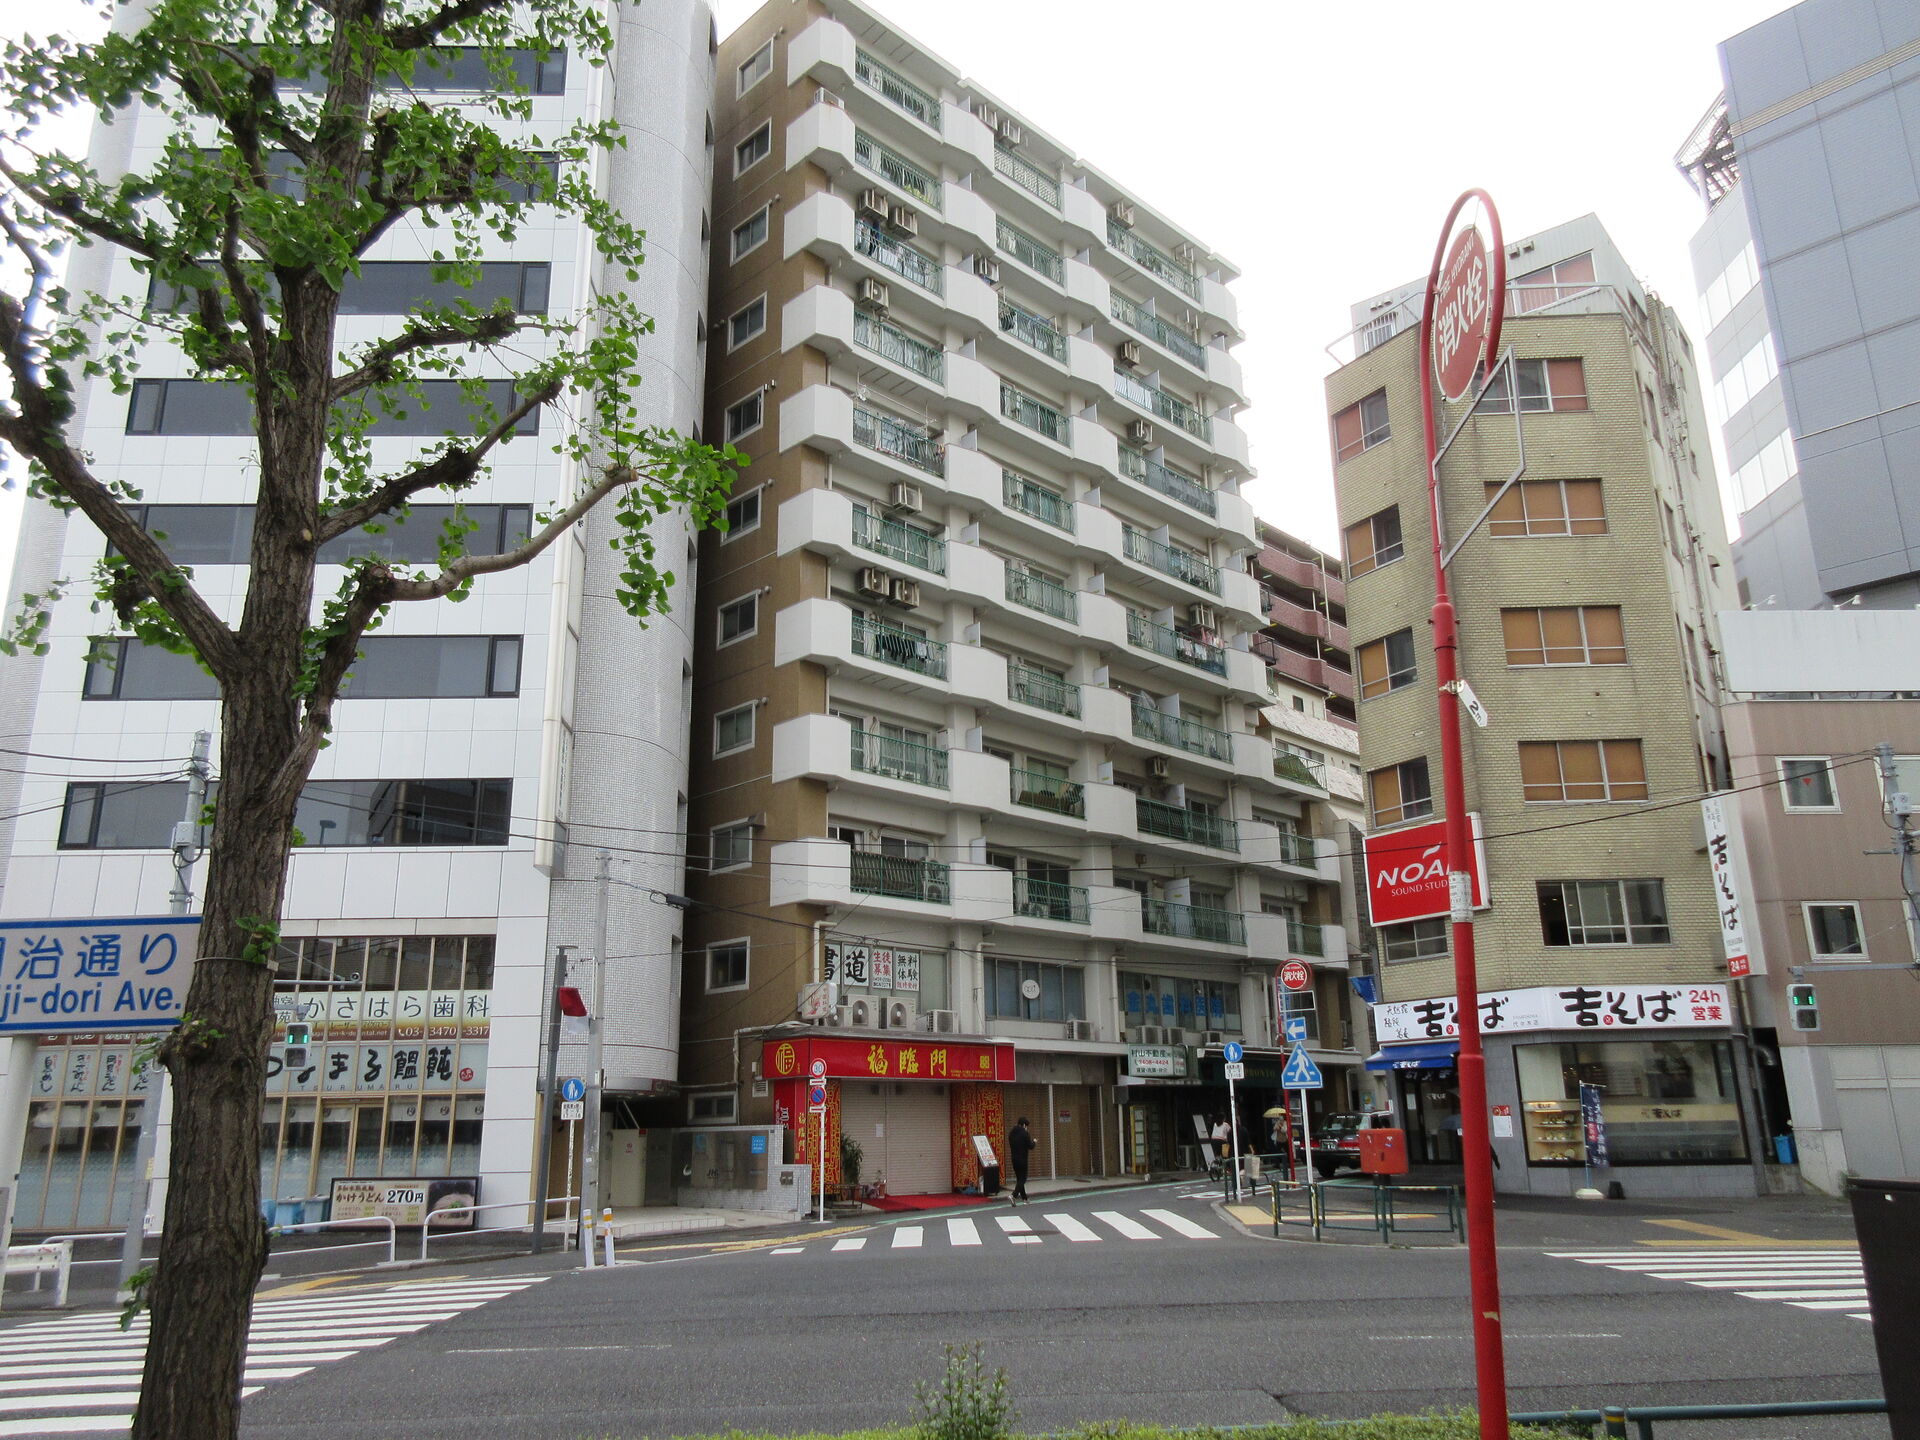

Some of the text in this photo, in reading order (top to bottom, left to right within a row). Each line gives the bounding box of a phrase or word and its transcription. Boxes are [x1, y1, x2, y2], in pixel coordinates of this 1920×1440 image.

[1451, 232, 1475, 283] HYDRANT
[1439, 256, 1485, 373] 消火栓
[1376, 859, 1450, 889] NOA
[1710, 834, 1739, 931] 吉そば
[1391, 884, 1423, 897] SOUND
[898, 953, 918, 968] 無料
[898, 968, 919, 981] 体験
[1283, 970, 1305, 981] 消火栓
[114, 980, 182, 1012] Ave.
[304, 994, 490, 1019] かさはら歯科
[1558, 986, 1683, 1027] 吉そば
[1688, 989, 1721, 1004] 24h
[1691, 1005, 1723, 1022] 営業
[266, 1045, 453, 1084] つまる饂飩
[867, 1045, 947, 1077] 福臨門
[336, 1192, 384, 1203] かけうどん
[387, 1190, 423, 1203] 270円
